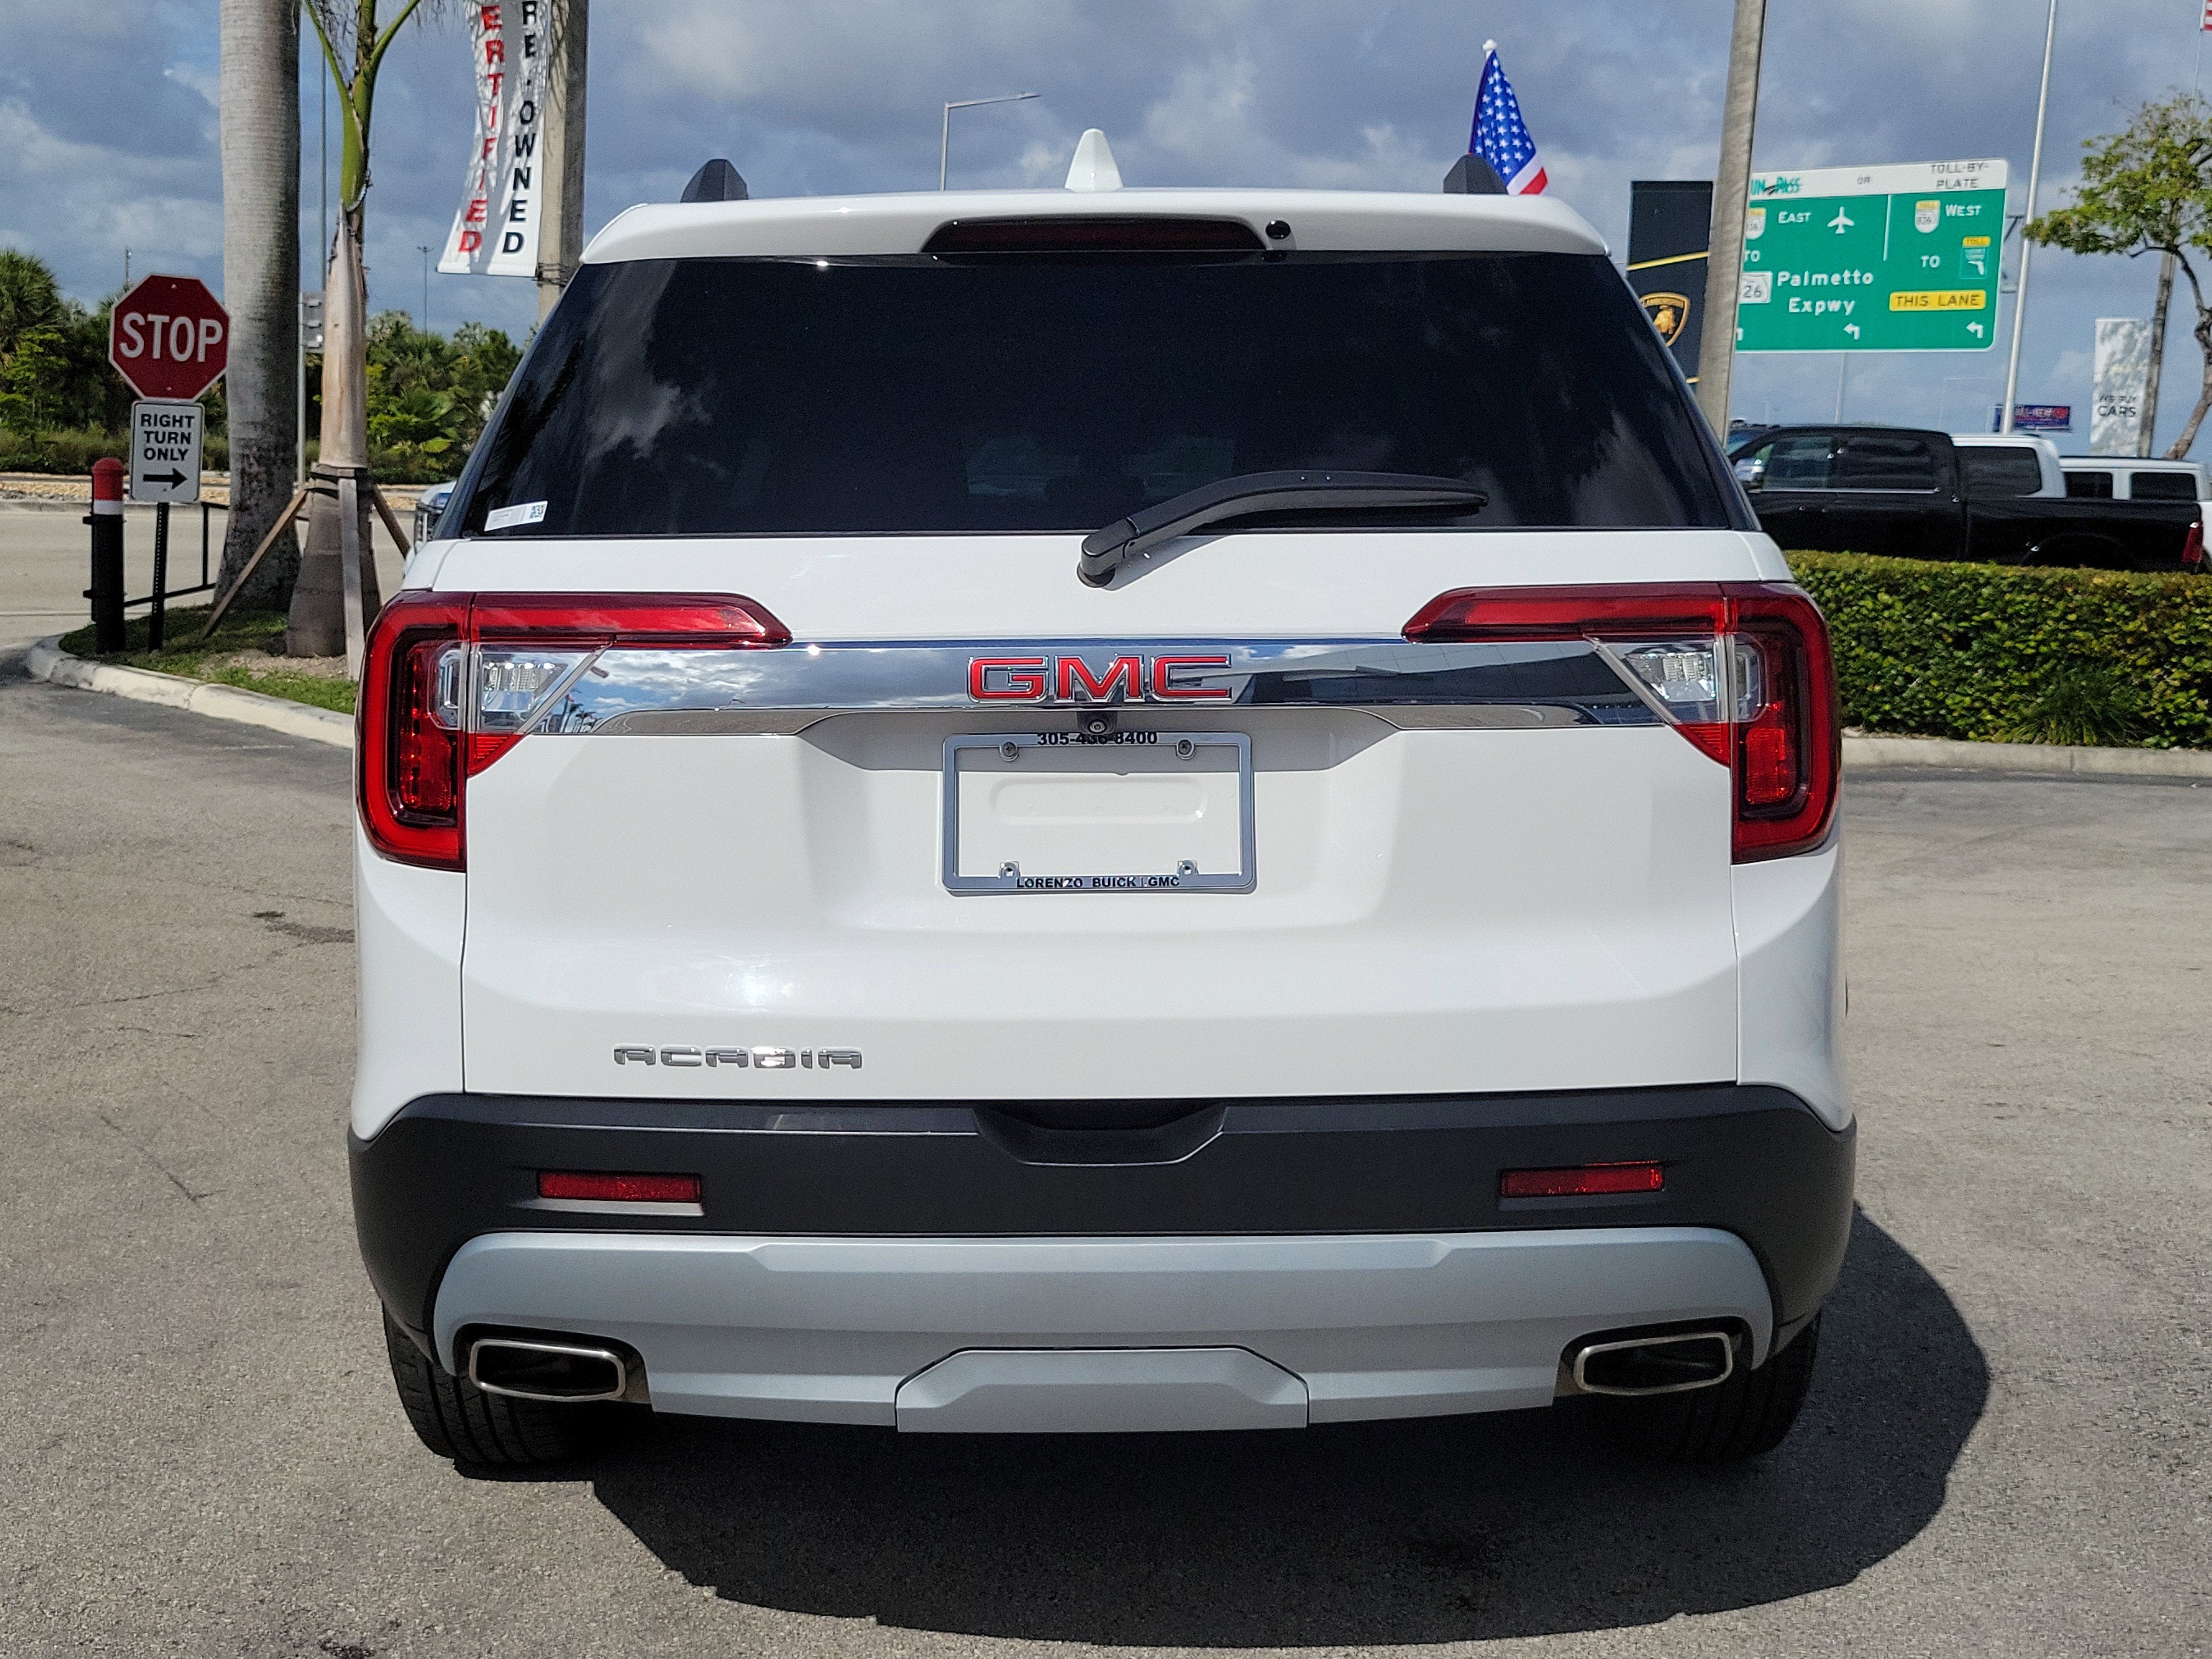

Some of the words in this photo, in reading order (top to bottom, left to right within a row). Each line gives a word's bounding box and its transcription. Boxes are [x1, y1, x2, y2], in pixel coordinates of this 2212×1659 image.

[459, 5, 505, 253] ERTIFIED
[502, 1, 538, 253] RE-OWNED
[1937, 179, 1978, 189] PLATE
[1778, 211, 1811, 224] EAST
[1945, 204, 1982, 217] WEST
[1745, 250, 1760, 262] TO
[1921, 255, 1940, 268] TO
[1777, 269, 1874, 286] Palmetto
[1739, 284, 1762, 298] 26
[1789, 297, 1855, 315] Expwy
[1896, 295, 1928, 307] THIS
[1938, 294, 1980, 306] LANE
[120, 312, 223, 363] STOP
[2097, 405, 2136, 417] CARS
[140, 414, 195, 428] RIGHT
[144, 431, 191, 445] TURN
[144, 447, 189, 461] ONLY
[968, 653, 1233, 704] GMC
[1017, 877, 1083, 888] LORENZO
[1092, 877, 1136, 887] BUICK
[1147, 876, 1180, 887] GMC
[613, 1044, 863, 1069] ACADIA
